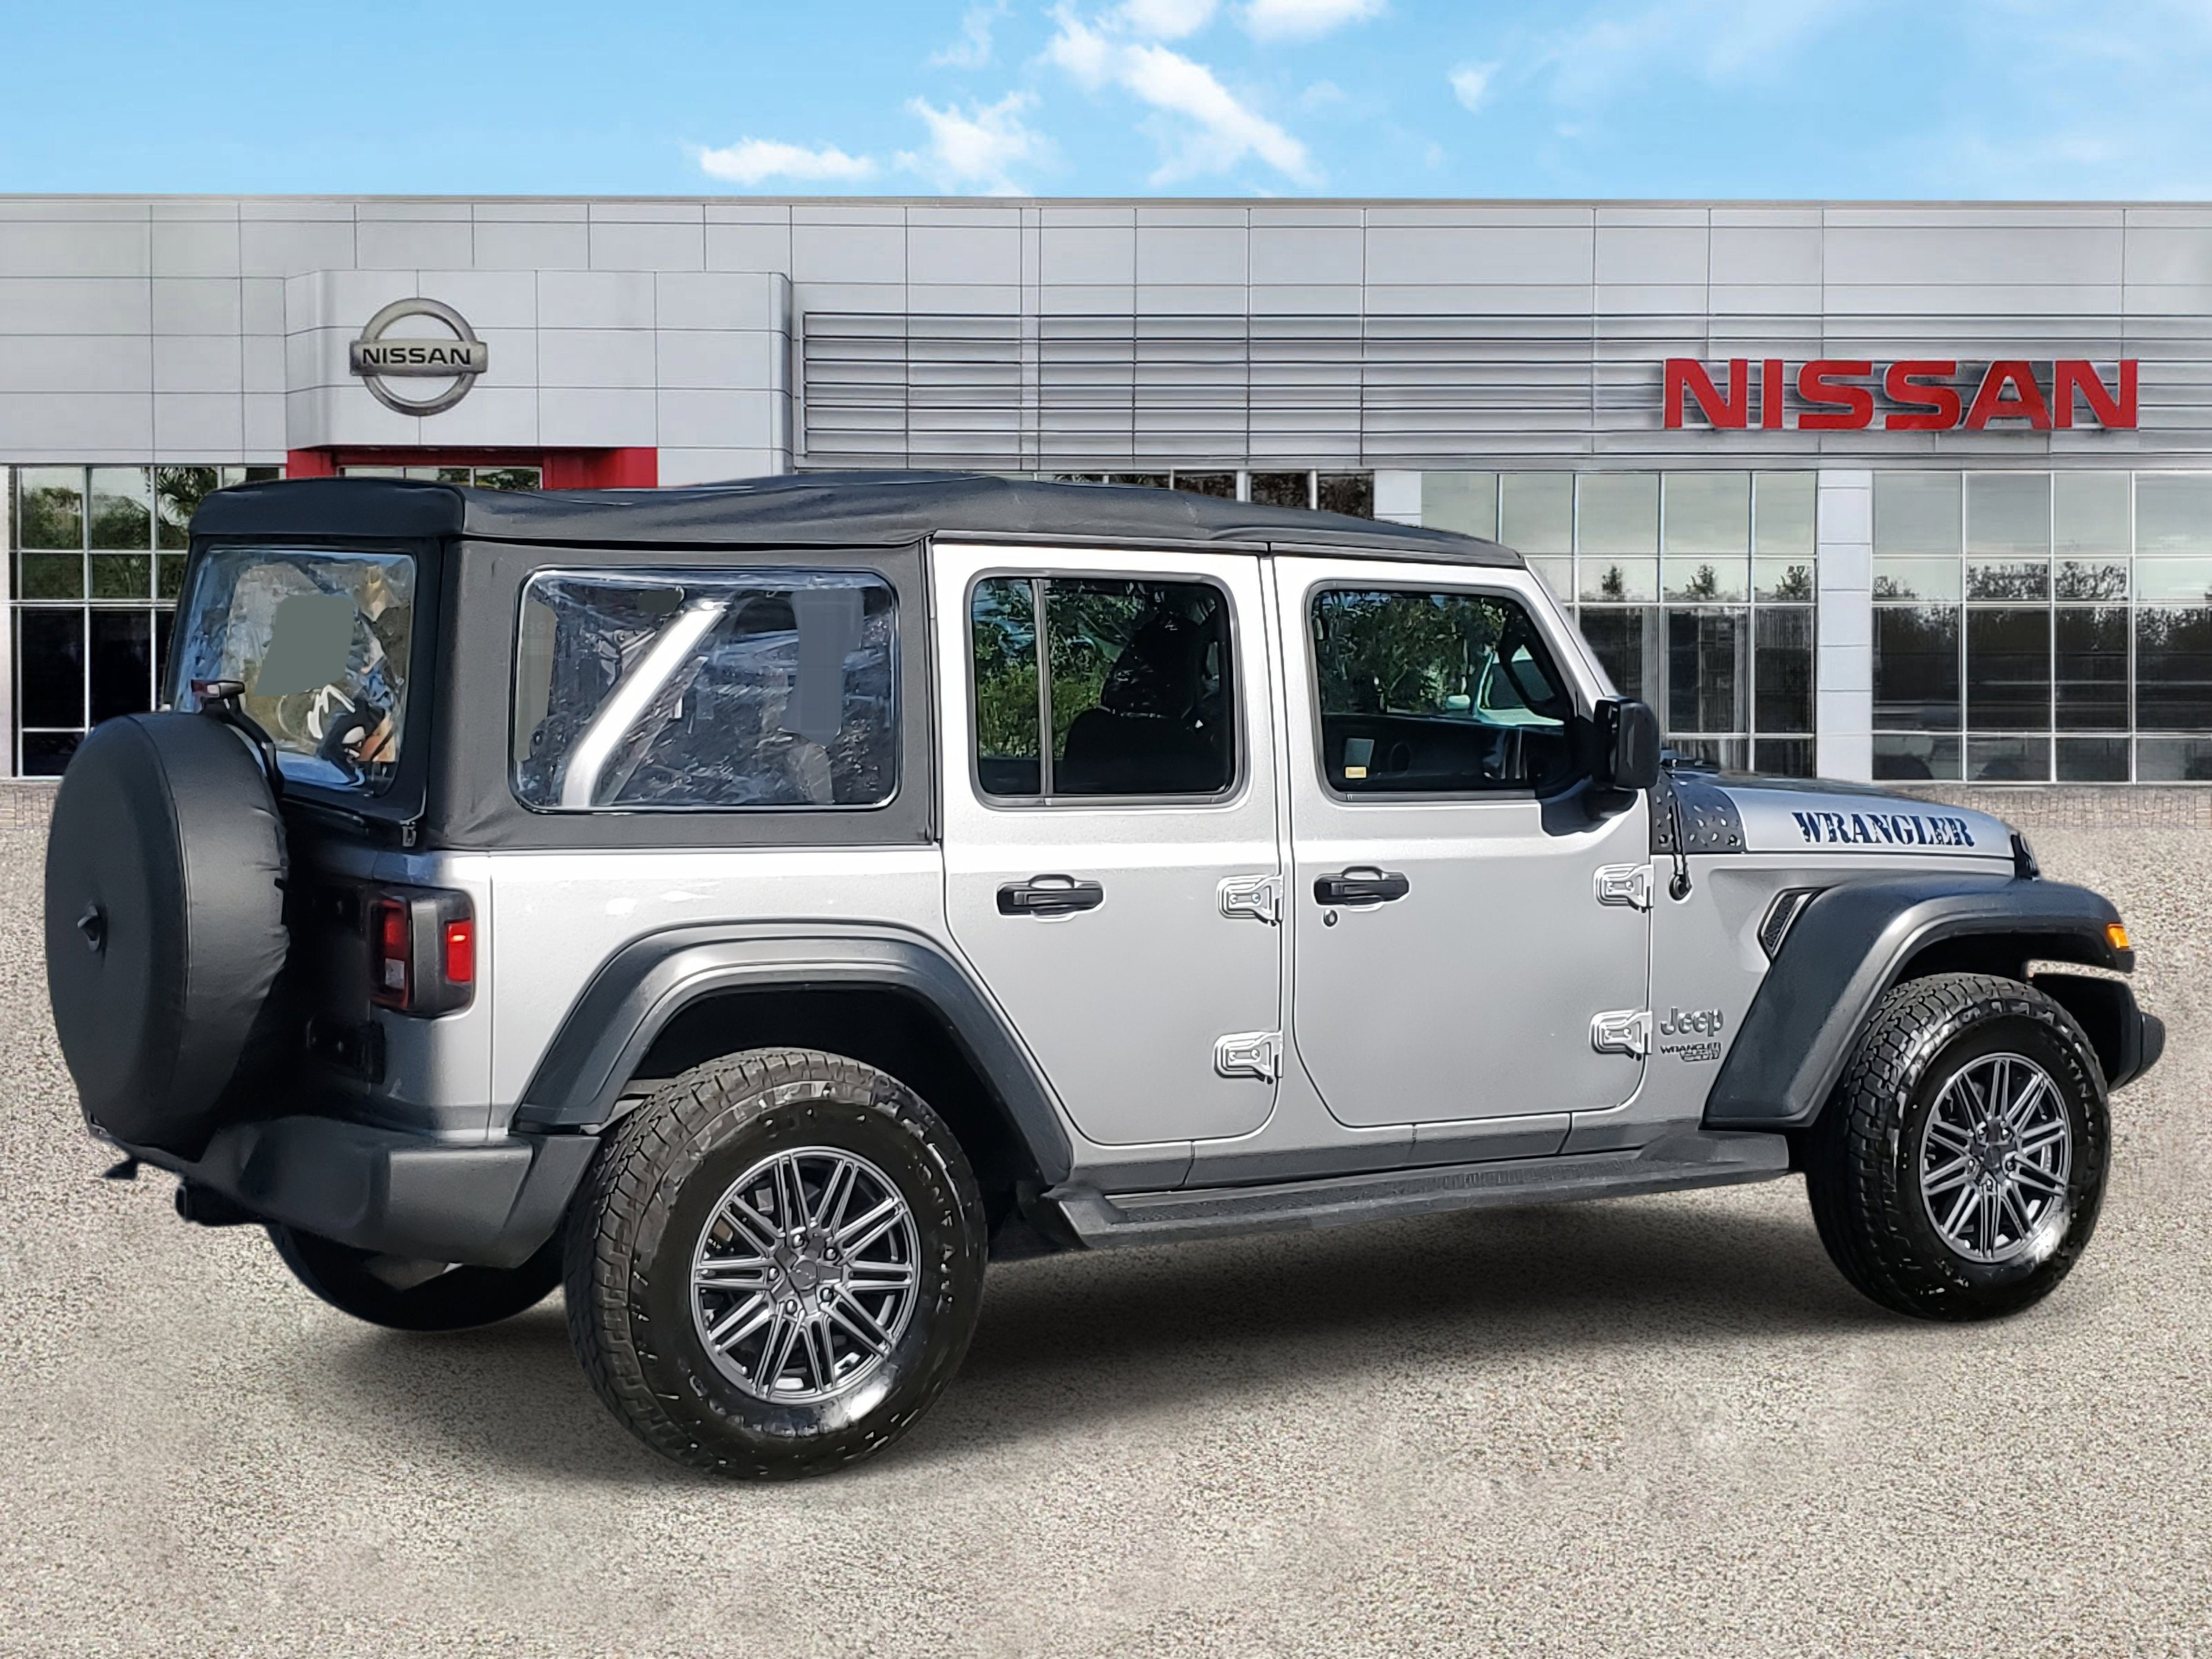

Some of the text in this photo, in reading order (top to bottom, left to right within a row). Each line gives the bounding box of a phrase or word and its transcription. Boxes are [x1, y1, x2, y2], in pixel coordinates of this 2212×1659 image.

[363, 348, 471, 366] NISSAN
[1664, 358, 2139, 430] NISSAN
[1791, 811, 1975, 847] WRANGLER
[1660, 1006, 1724, 1037] Jeep
